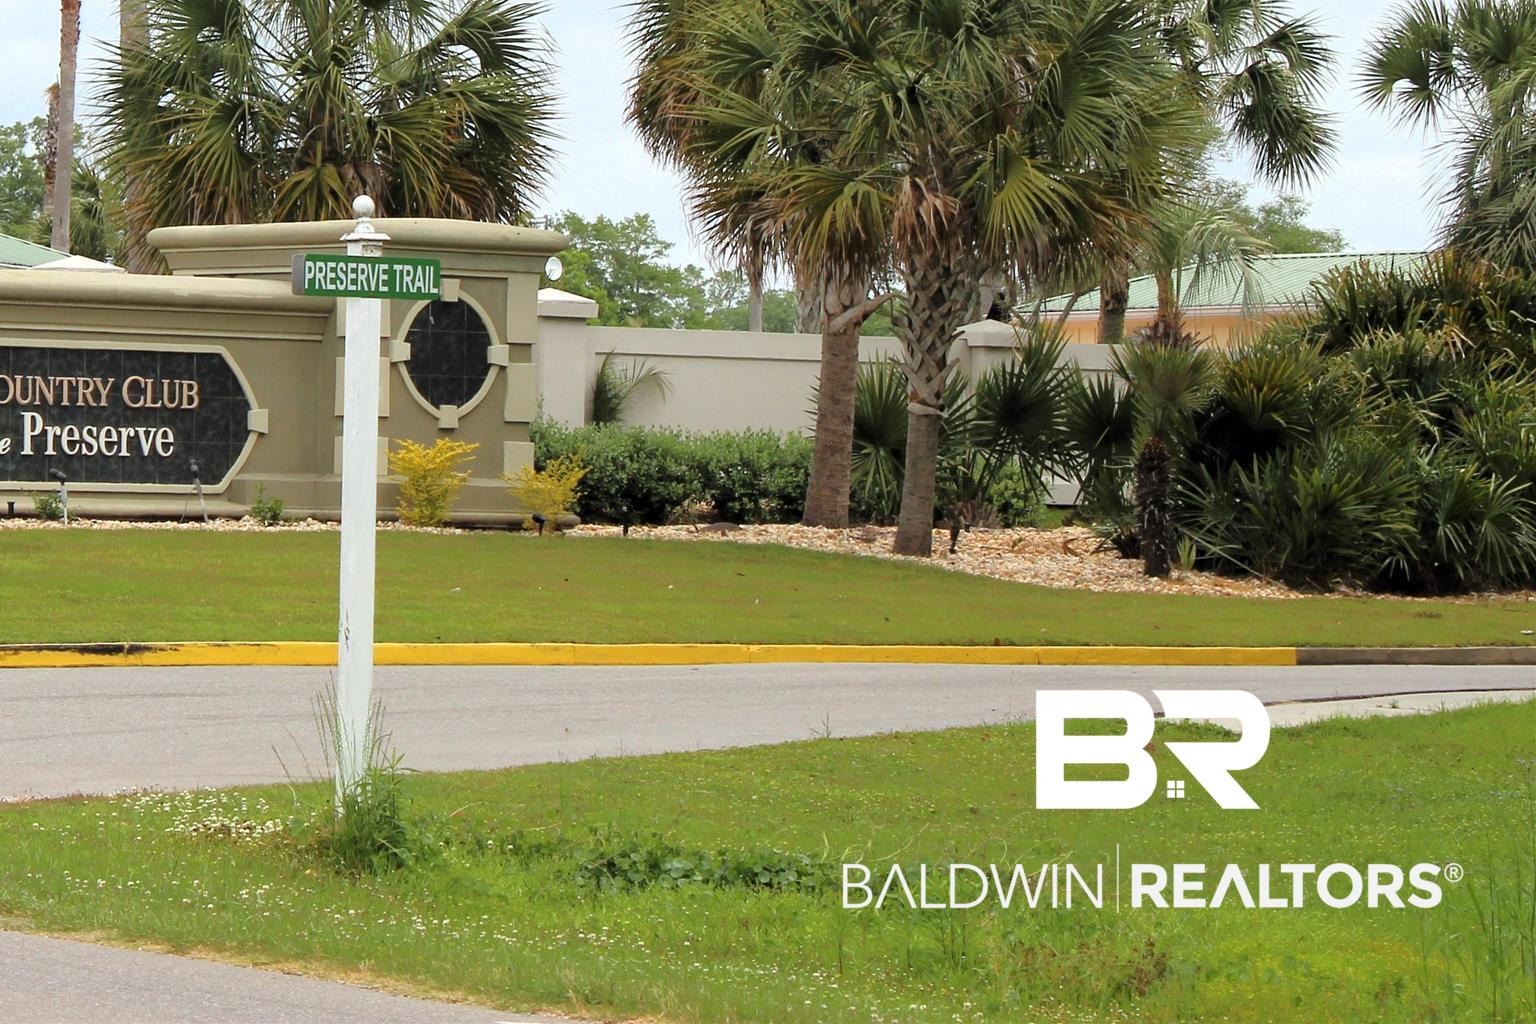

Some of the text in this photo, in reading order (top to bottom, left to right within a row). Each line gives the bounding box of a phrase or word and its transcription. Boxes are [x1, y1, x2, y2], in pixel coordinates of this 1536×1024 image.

[304, 260, 439, 294] PRESERVE TRAIL
[122, 375, 201, 411] CLUB
[21, 410, 176, 458] Preserve
